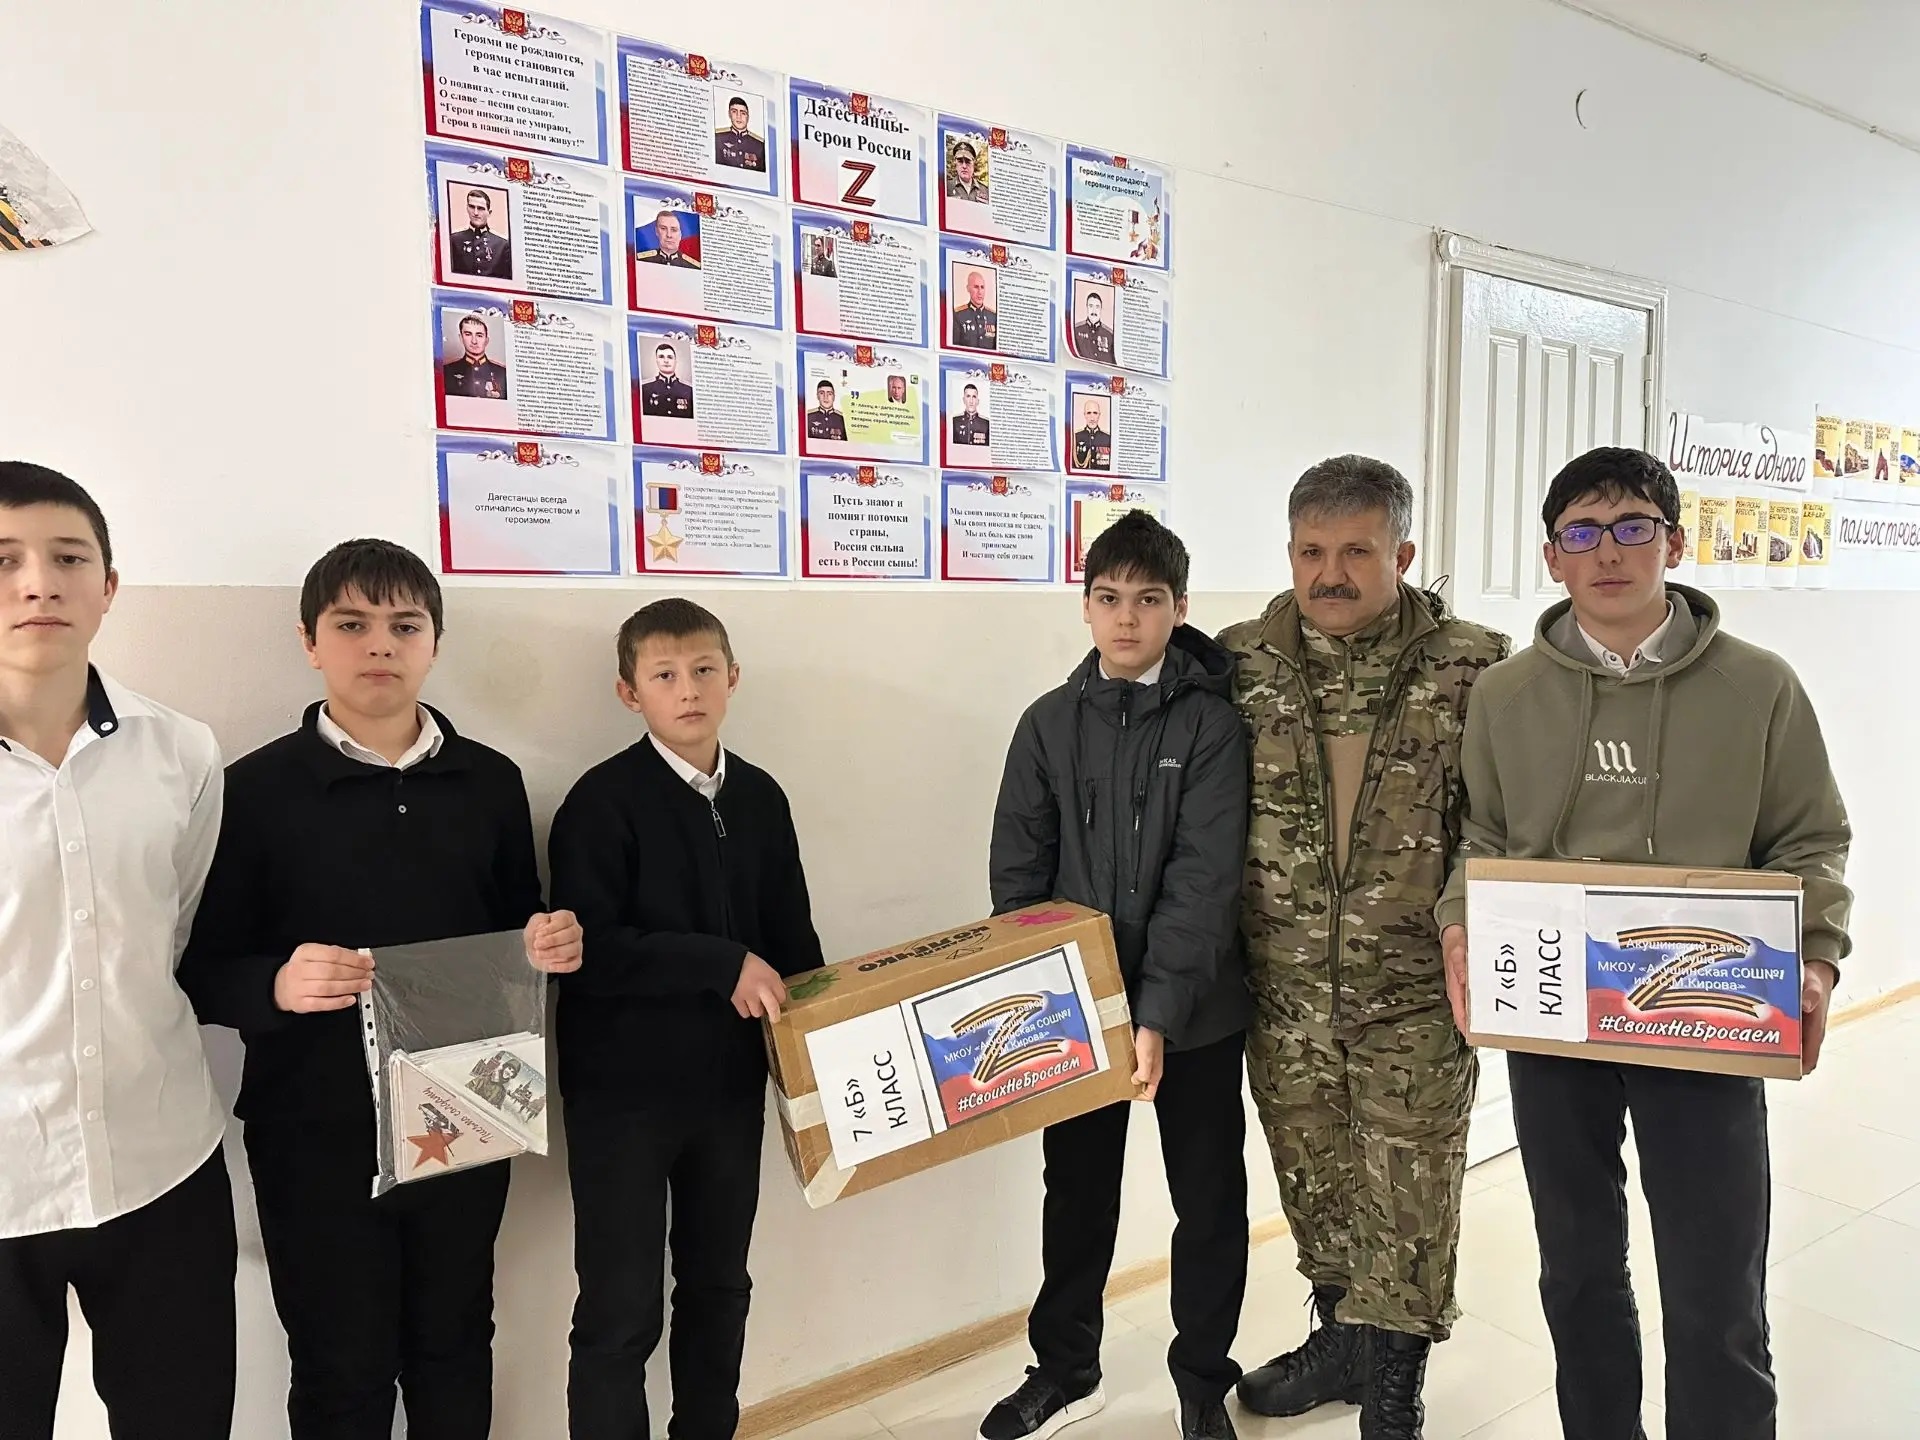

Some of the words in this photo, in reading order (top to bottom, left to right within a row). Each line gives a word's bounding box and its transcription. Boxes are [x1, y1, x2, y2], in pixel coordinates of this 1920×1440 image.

[453, 29, 502, 48] Героями
[506, 42, 518, 51] не
[521, 44, 584, 66] рождаются,
[464, 48, 512, 65] героями
[514, 59, 575, 78] становятся
[473, 65, 480, 73] в
[483, 66, 502, 78] час
[504, 71, 570, 92] испытаний.
[439, 76, 448, 86] О
[450, 79, 494, 94] подвигах
[502, 90, 528, 101] стихи
[531, 94, 570, 109] слагают.
[439, 90, 448, 98] О
[450, 93, 478, 104] славе
[487, 100, 514, 111] песни
[516, 105, 554, 118] создают.
[441, 115, 469, 129] Герои
[480, 123, 510, 135] нашей
[512, 129, 546, 142] памяти
[476, 110, 514, 124] никогда
[516, 116, 526, 126] не
[803, 123, 852, 150] Герои
[856, 135, 912, 161] России
[1079, 166, 1107, 178] Героями
[1668, 412, 1753, 479] История
[1754, 424, 1806, 483] одного
[475, 504, 525, 514] отличались
[527, 506, 572, 516] мужеством
[488, 492, 538, 504] Дагестанцы
[540, 495, 567, 504] всегда
[833, 494, 863, 507] Пусть
[866, 498, 895, 507] знают
[828, 512, 864, 521] помнят
[868, 514, 908, 523] потомки
[954, 518, 966, 526] Мы
[834, 541, 867, 551] Россия
[870, 544, 904, 552] сильна
[849, 528, 889, 538] страны,
[818, 558, 840, 566] есть
[852, 556, 885, 567] России
[888, 558, 918, 568] сыны!
[858, 926, 990, 972] КОЛЕЧКО
[1626, 938, 1708, 952] Акушинский
[1496, 943, 1517, 990] «Б»
[1538, 928, 1562, 1016] КЛАСС
[1598, 961, 1636, 973] МКОУ
[1638, 964, 1728, 978] «Акушинская
[1731, 967, 1785, 980] СОШ№1
[1496, 998, 1518, 1012] 7
[1598, 1015, 1781, 1044] #СвоихНеБросаем
[944, 1046, 972, 1064] МКОУ
[974, 1024, 1036, 1051] «Акушинская
[873, 1050, 908, 1129] КЛАСС
[958, 1056, 1080, 1112] #СвоихНеБросаем
[845, 1078, 866, 1120] «Б»
[460, 1116, 494, 1144] Письмо
[854, 1128, 872, 1142] 7
